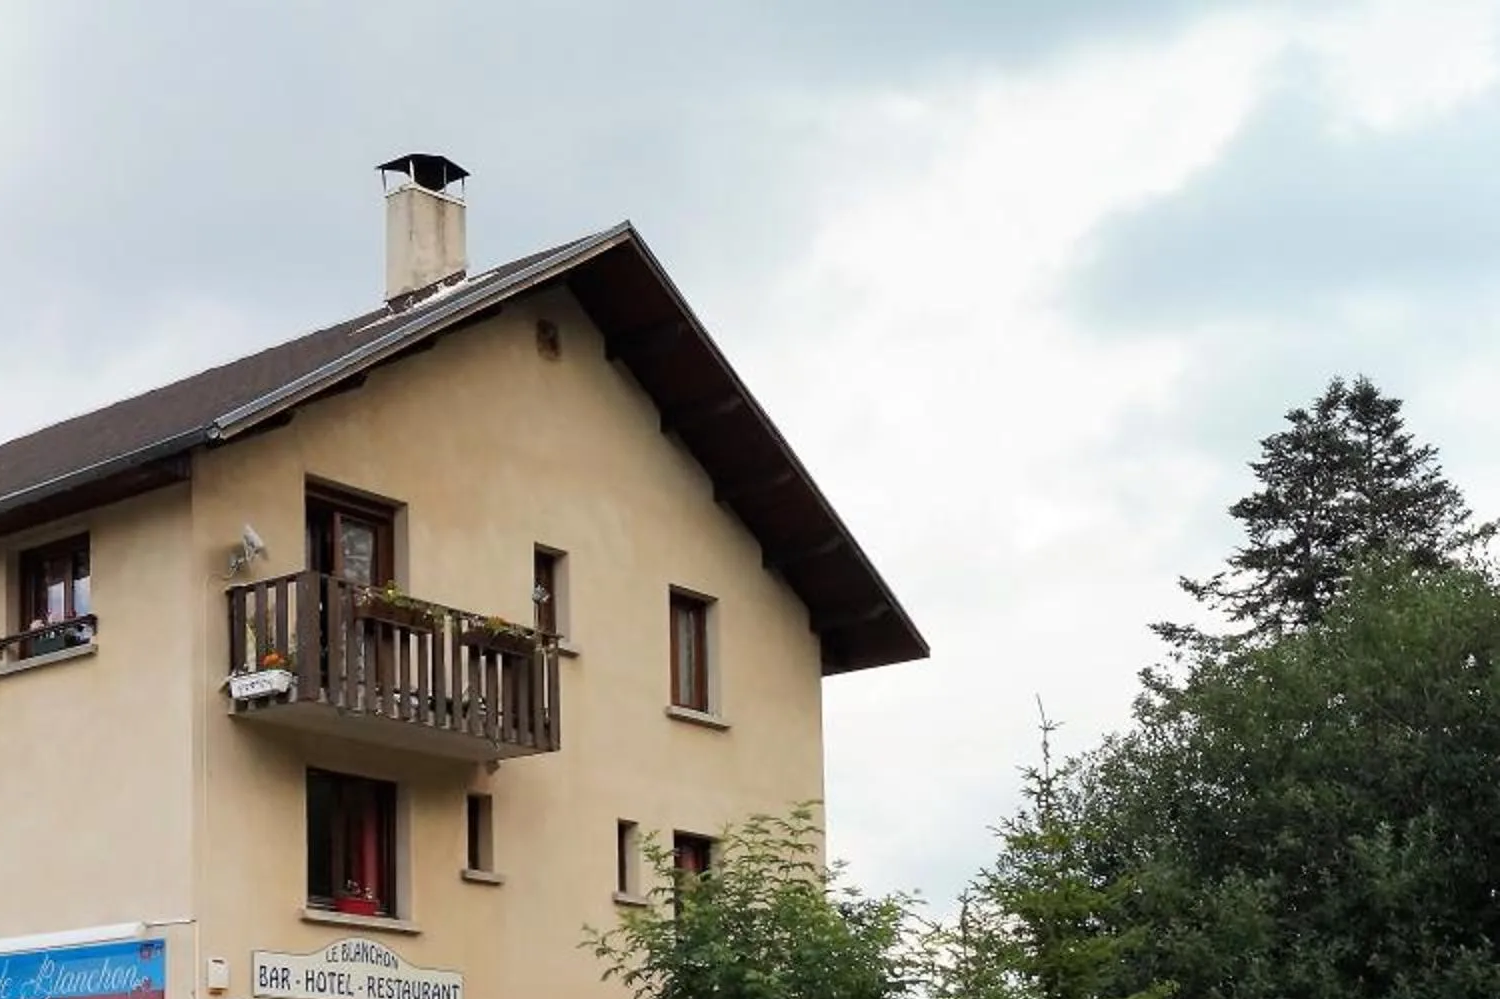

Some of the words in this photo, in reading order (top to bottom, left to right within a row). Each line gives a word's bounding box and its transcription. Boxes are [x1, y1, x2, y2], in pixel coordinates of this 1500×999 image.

[326, 947, 338, 963] LE
[341, 942, 398, 970] BLANCHON
[259, 965, 291, 990] BAR
[305, 969, 354, 996] HOTEL
